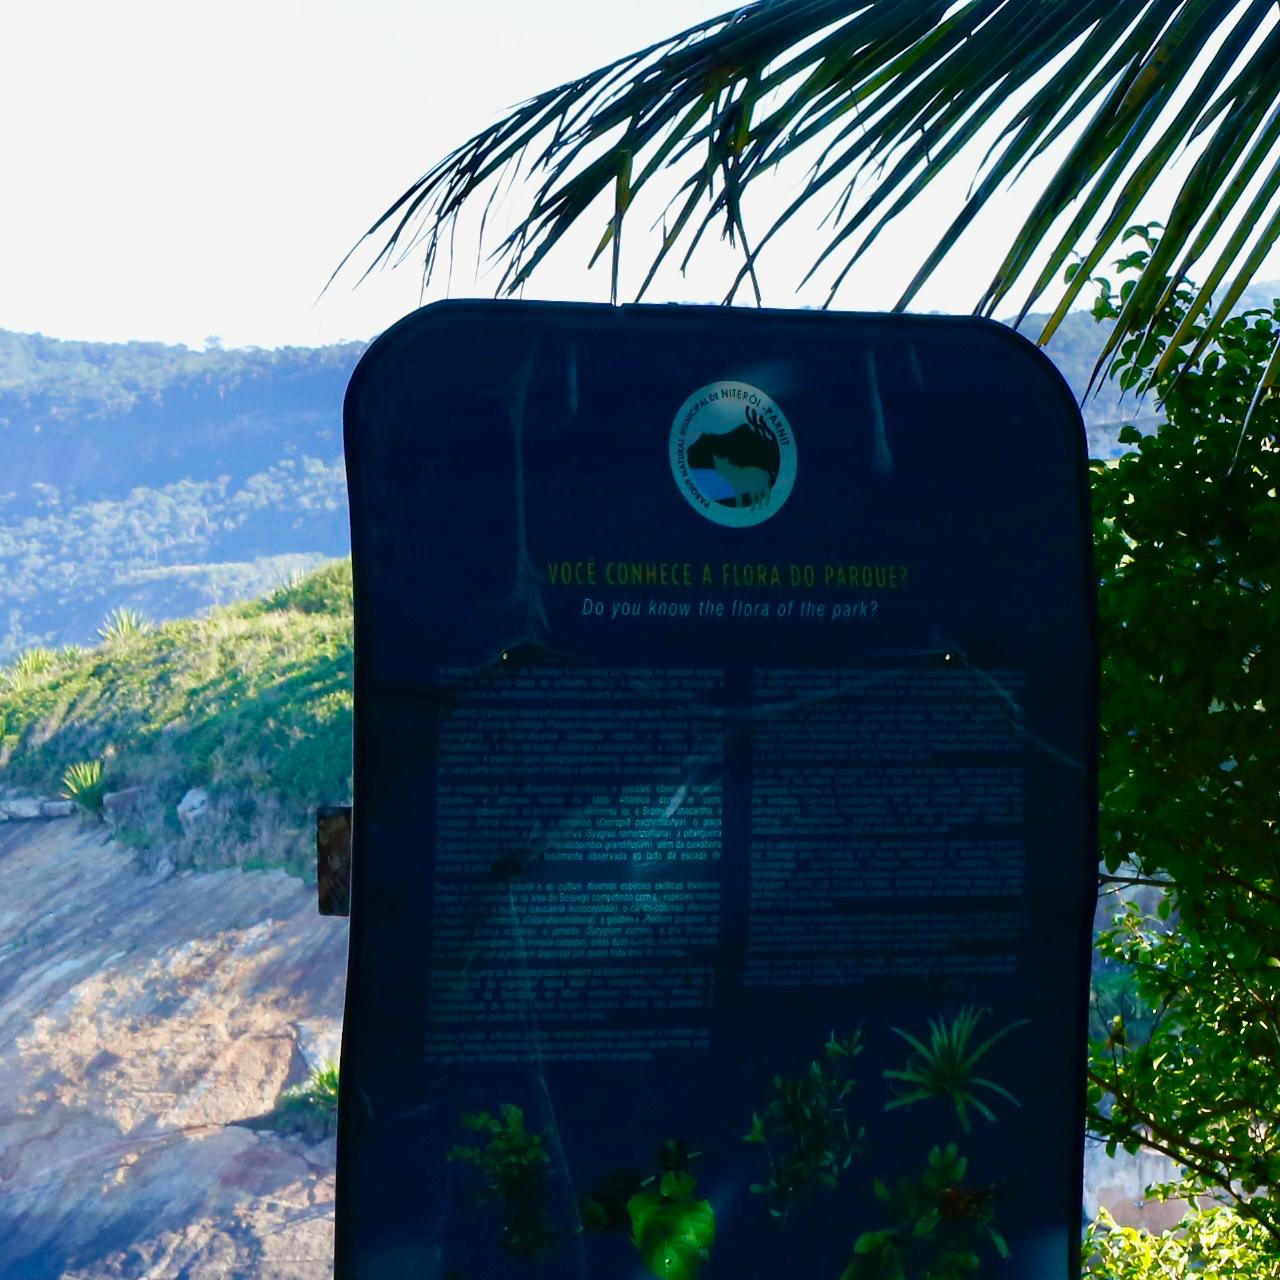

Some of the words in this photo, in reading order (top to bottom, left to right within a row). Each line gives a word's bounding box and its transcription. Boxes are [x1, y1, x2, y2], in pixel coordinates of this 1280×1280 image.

[720, 388, 762, 407] NITERÓI
[547, 557, 596, 585] VOCÊ
[605, 561, 692, 587] CONHECE
[701, 563, 713, 586] A
[722, 562, 781, 587] FLORA
[789, 564, 815, 587] DO
[824, 564, 908, 588] PARQUE?
[582, 597, 604, 616] Do
[611, 601, 641, 620] you
[648, 599, 691, 617] know
[698, 599, 725, 617] the
[732, 599, 769, 617] flora
[776, 599, 794, 617] of
[800, 600, 825, 617] the
[831, 600, 879, 621] park?
